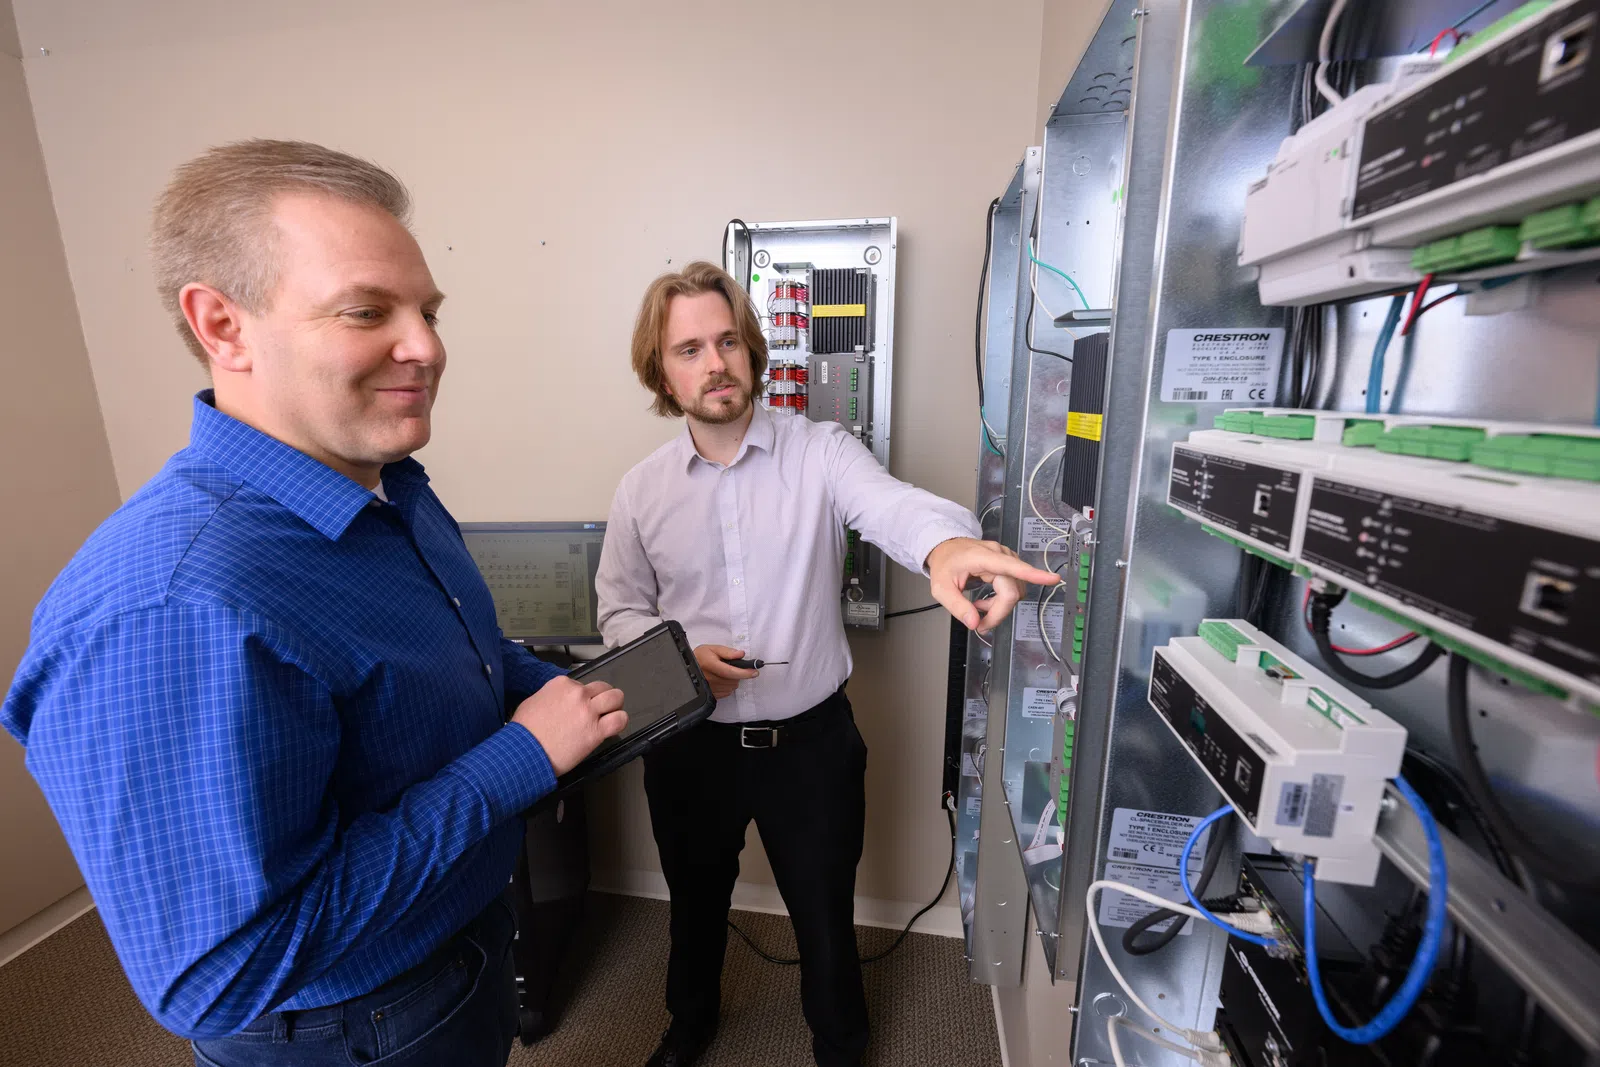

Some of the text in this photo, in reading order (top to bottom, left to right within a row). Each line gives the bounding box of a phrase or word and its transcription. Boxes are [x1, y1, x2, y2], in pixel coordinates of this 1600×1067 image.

[1193, 333, 1271, 342] CRESTRON
[1137, 812, 1190, 822] CRESTRON
[1143, 844, 1156, 853] CE
[1112, 864, 1152, 873] CRESTRON
